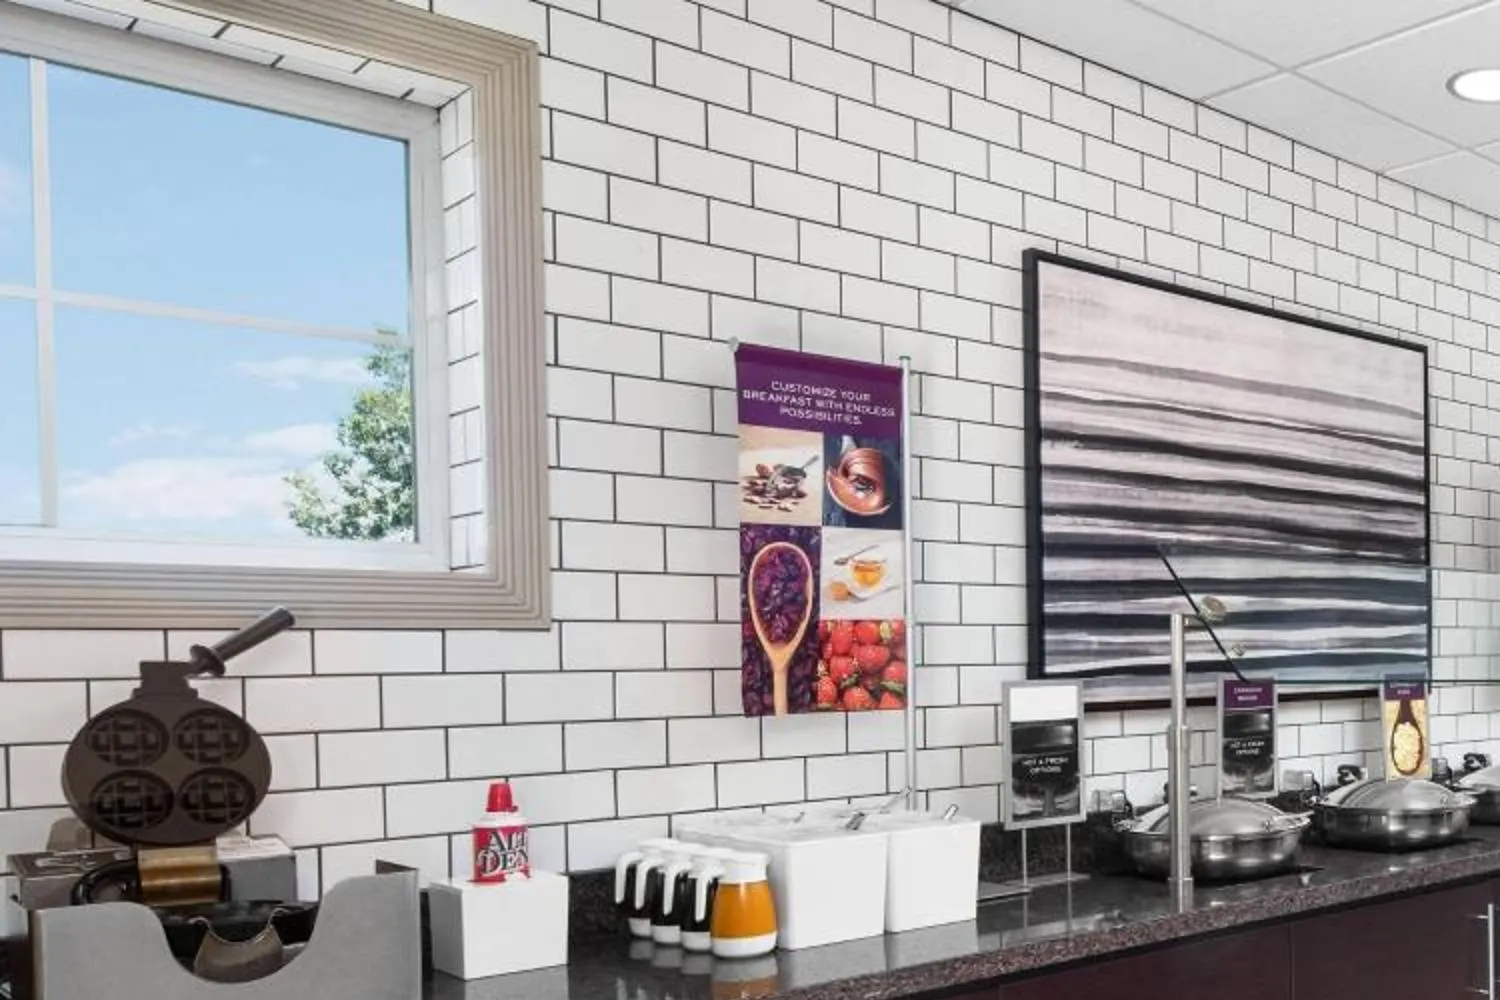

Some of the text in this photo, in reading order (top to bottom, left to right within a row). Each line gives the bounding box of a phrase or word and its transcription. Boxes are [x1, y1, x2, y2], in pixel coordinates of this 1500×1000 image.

[743, 389, 896, 417] BREAKFAST WITH ENDLESS
[771, 380, 872, 402] CUSTOMIZE YOUR
